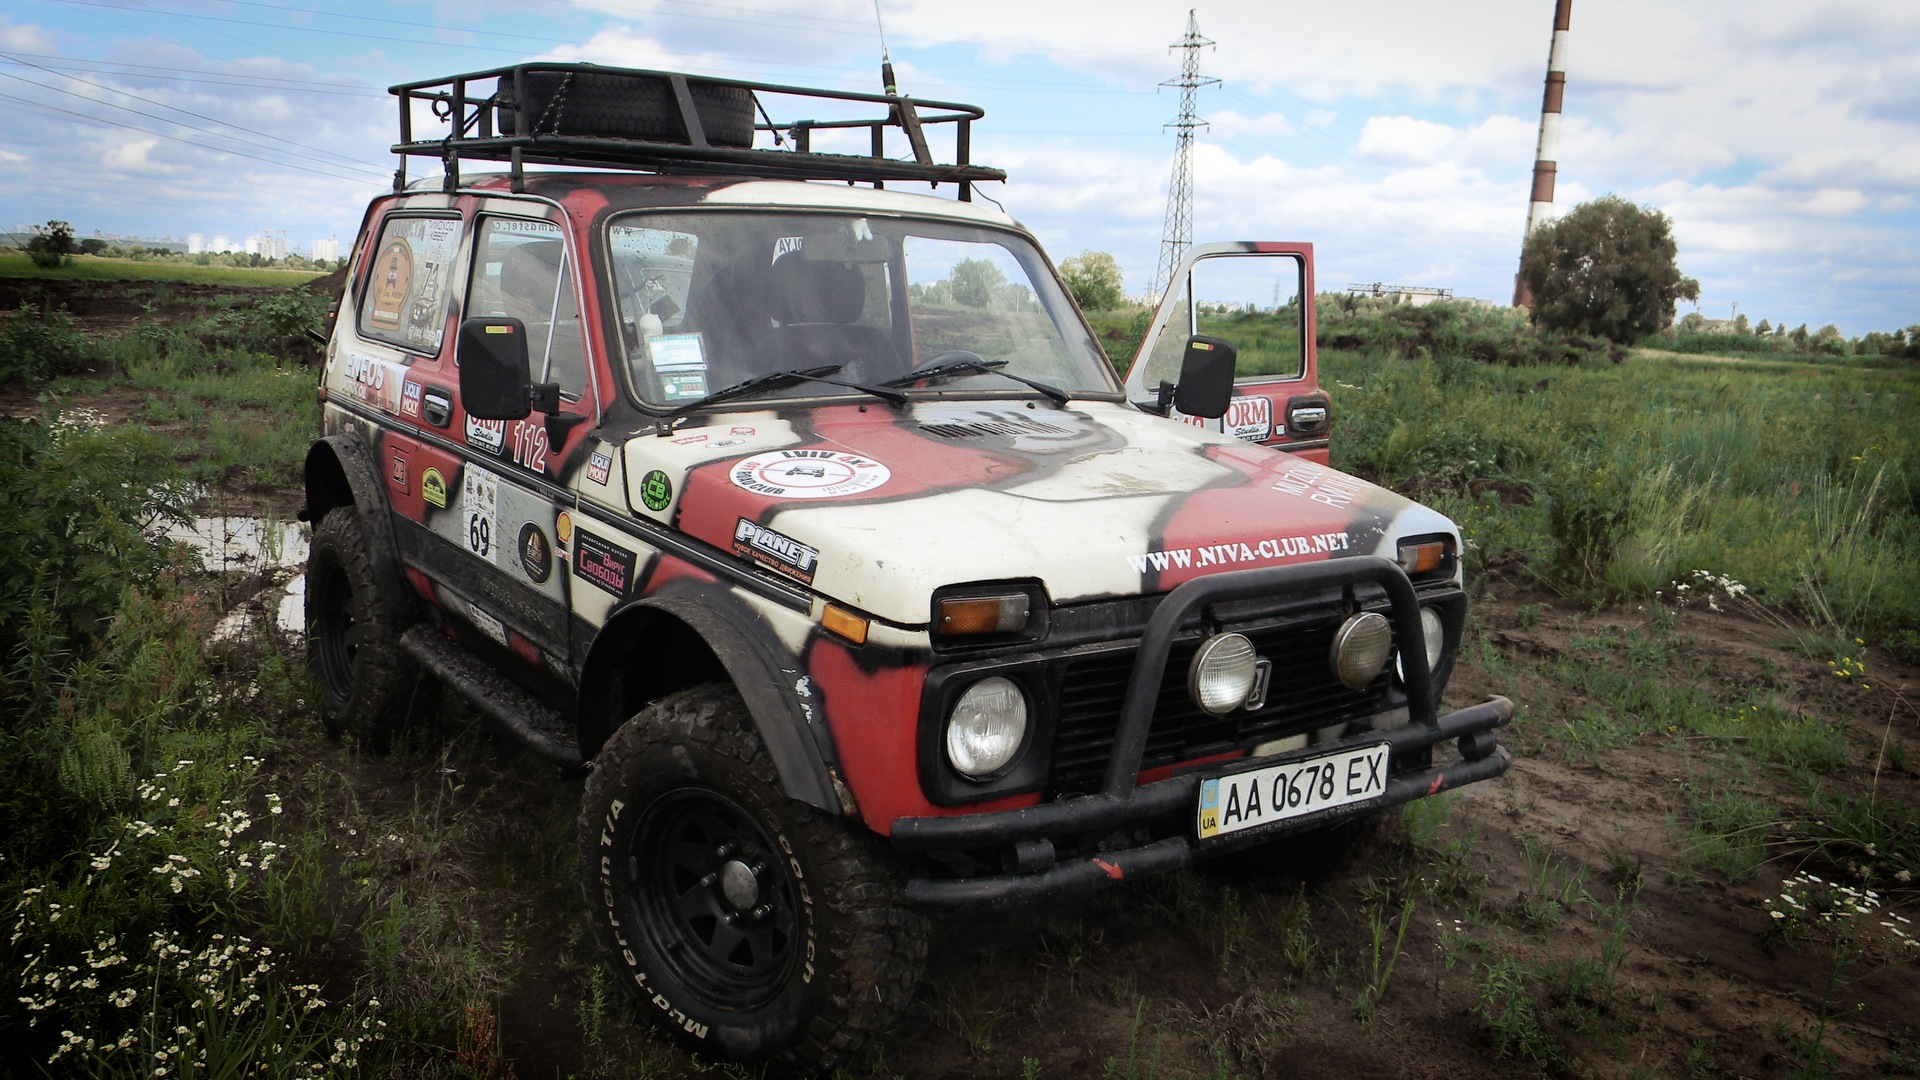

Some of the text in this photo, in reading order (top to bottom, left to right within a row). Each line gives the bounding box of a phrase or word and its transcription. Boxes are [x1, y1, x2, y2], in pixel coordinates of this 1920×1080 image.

[345, 353, 384, 390] ENEOS
[474, 427, 493, 441] Studio
[1234, 426, 1261, 436] Studio
[513, 420, 549, 474] 112
[782, 451, 836, 459] LVIV
[589, 465, 607, 483] MOLY
[592, 454, 609, 471] LIQUI
[647, 479, 666, 500] CB
[751, 483, 786, 495] CLUB
[470, 514, 489, 556] 69
[735, 518, 818, 571] PLANET
[734, 543, 812, 582] НОВОЕ КАЧЕСТВО ДВИЖЕНИЯ
[1125, 532, 1349, 575] WWW.NIVA-CLUB.NET
[1223, 752, 1383, 826] AA 0678 EX
[601, 799, 625, 848] T/A
[1202, 817, 1217, 830] UA
